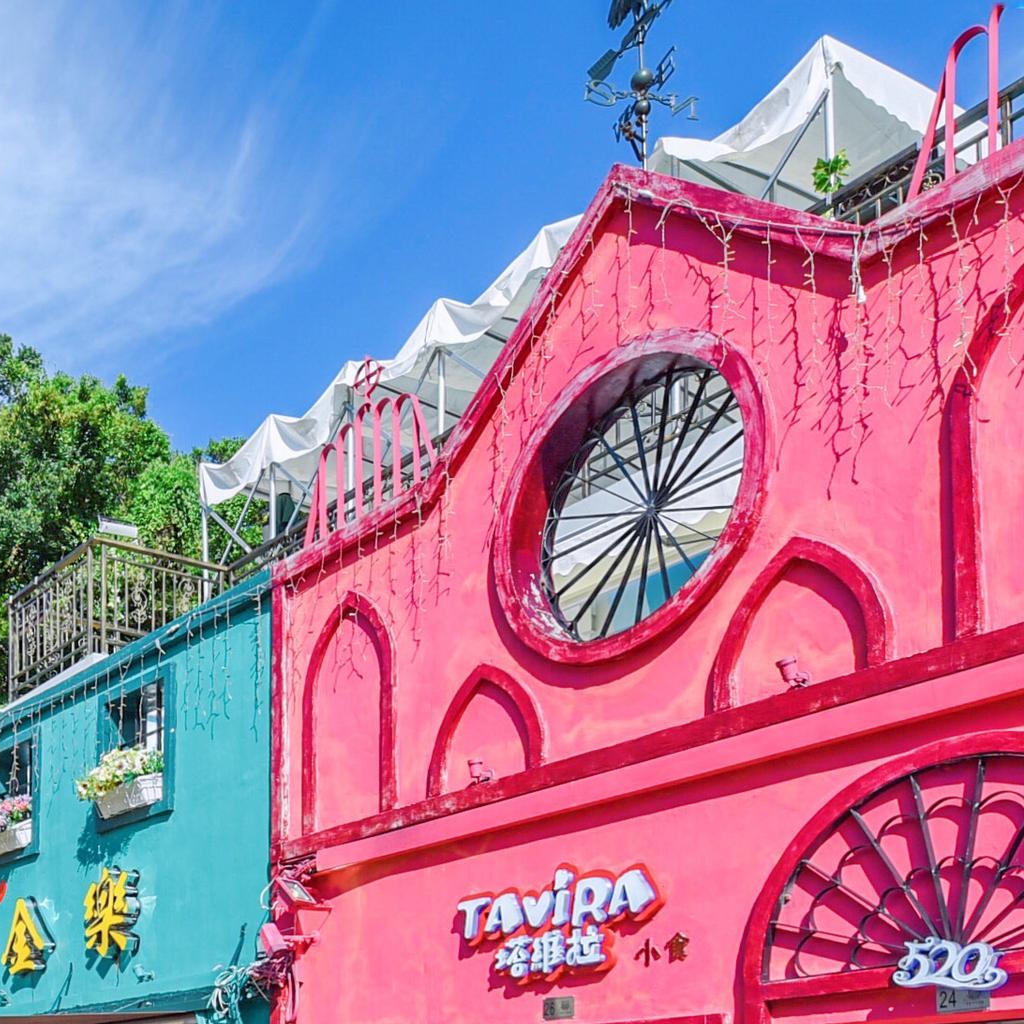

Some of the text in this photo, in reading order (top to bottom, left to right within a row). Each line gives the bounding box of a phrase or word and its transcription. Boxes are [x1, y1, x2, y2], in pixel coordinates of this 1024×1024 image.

[495, 925, 607, 978] 塔維拉
[634, 931, 690, 968] 小食
[939, 990, 956, 1009] 24
